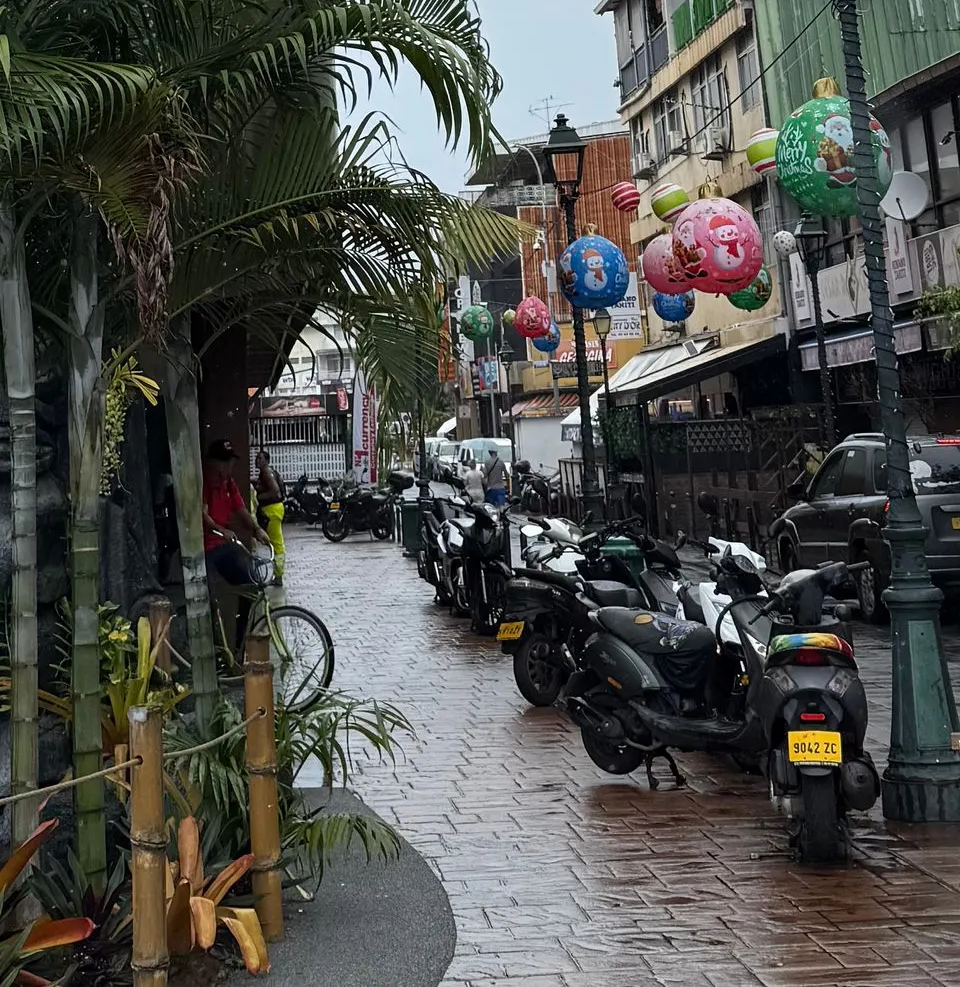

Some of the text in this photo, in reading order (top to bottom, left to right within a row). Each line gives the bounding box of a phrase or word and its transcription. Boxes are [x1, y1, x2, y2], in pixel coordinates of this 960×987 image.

[778, 140, 807, 163] Merry
[361, 394, 369, 450] currency
[793, 742, 837, 754] 9042 ZC
